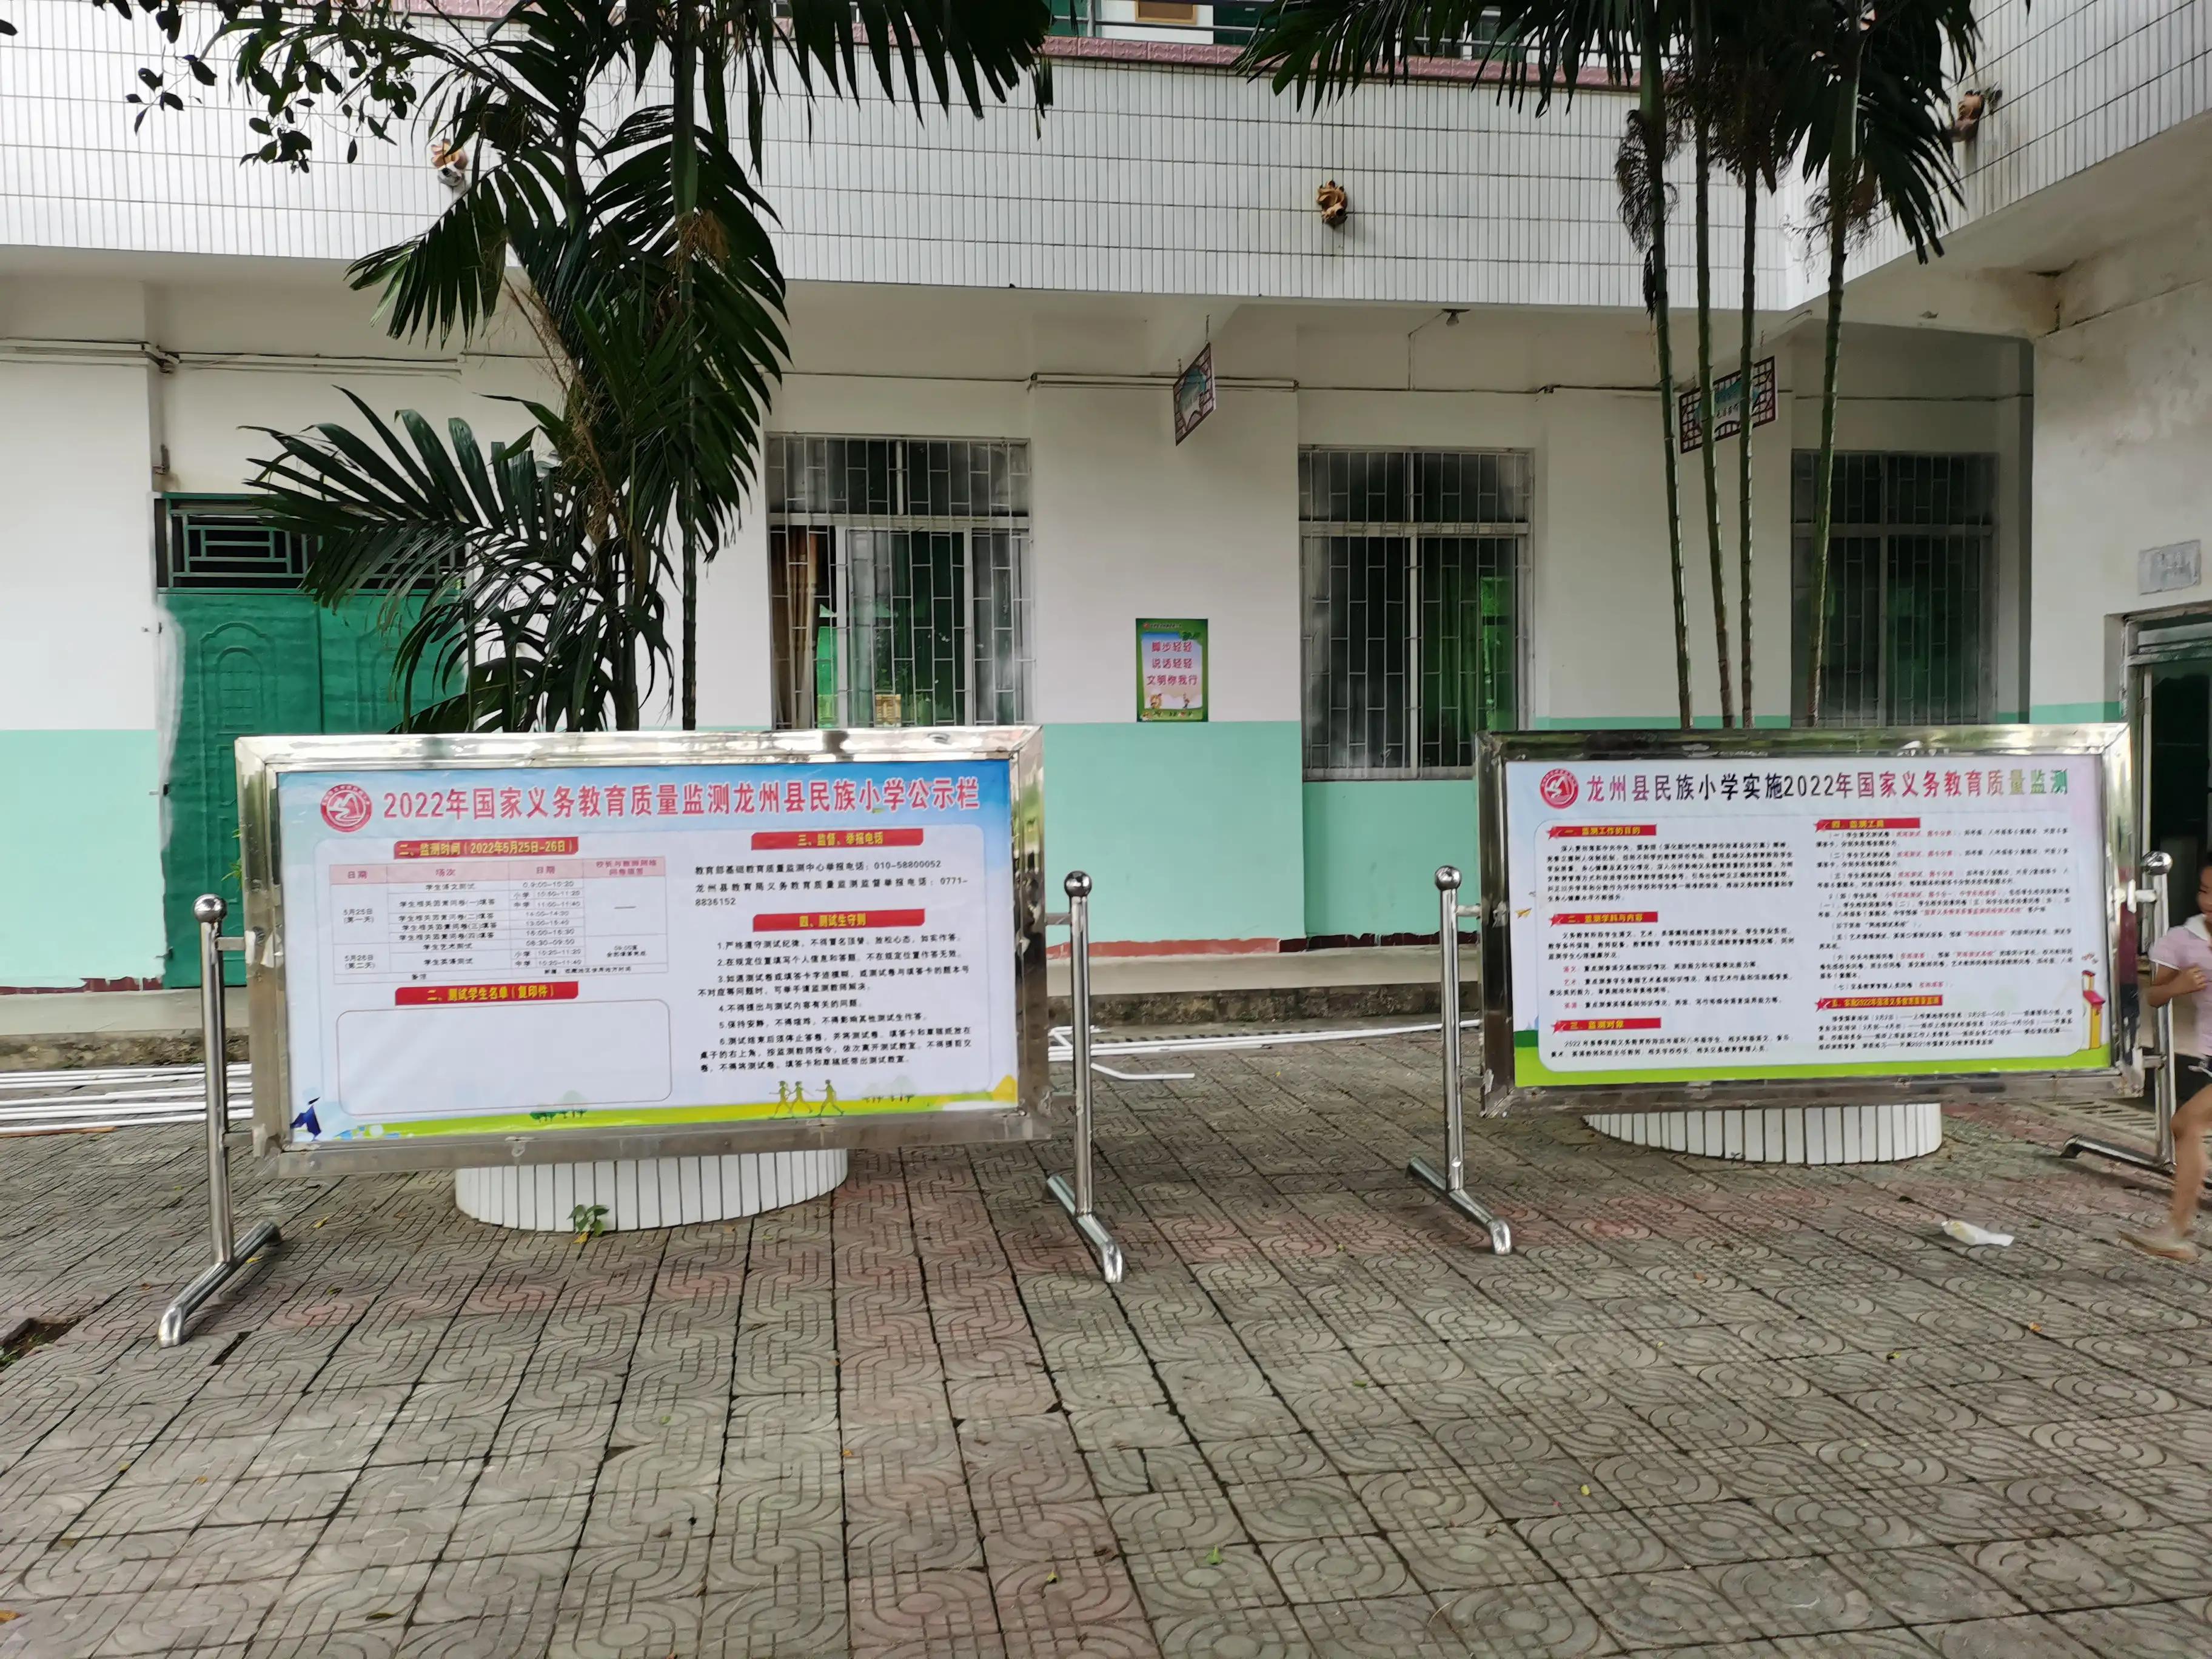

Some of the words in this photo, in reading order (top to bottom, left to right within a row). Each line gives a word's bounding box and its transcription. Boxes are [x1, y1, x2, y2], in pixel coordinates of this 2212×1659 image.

[1152, 658, 1193, 669] 说话轻轻
[1147, 674, 1198, 686] 文明你我行
[1587, 768, 2068, 802] 龙州县民族小学实施2022年国家义务教育质量监测
[383, 776, 980, 821] 2022年国家义务教育质量监测龙州县民族小学公示栏
[797, 831, 883, 846] 三、监督、举报电话
[435, 868, 456, 877] 场次
[536, 866, 555, 874] 日期
[799, 912, 866, 928] 四、测试生守则
